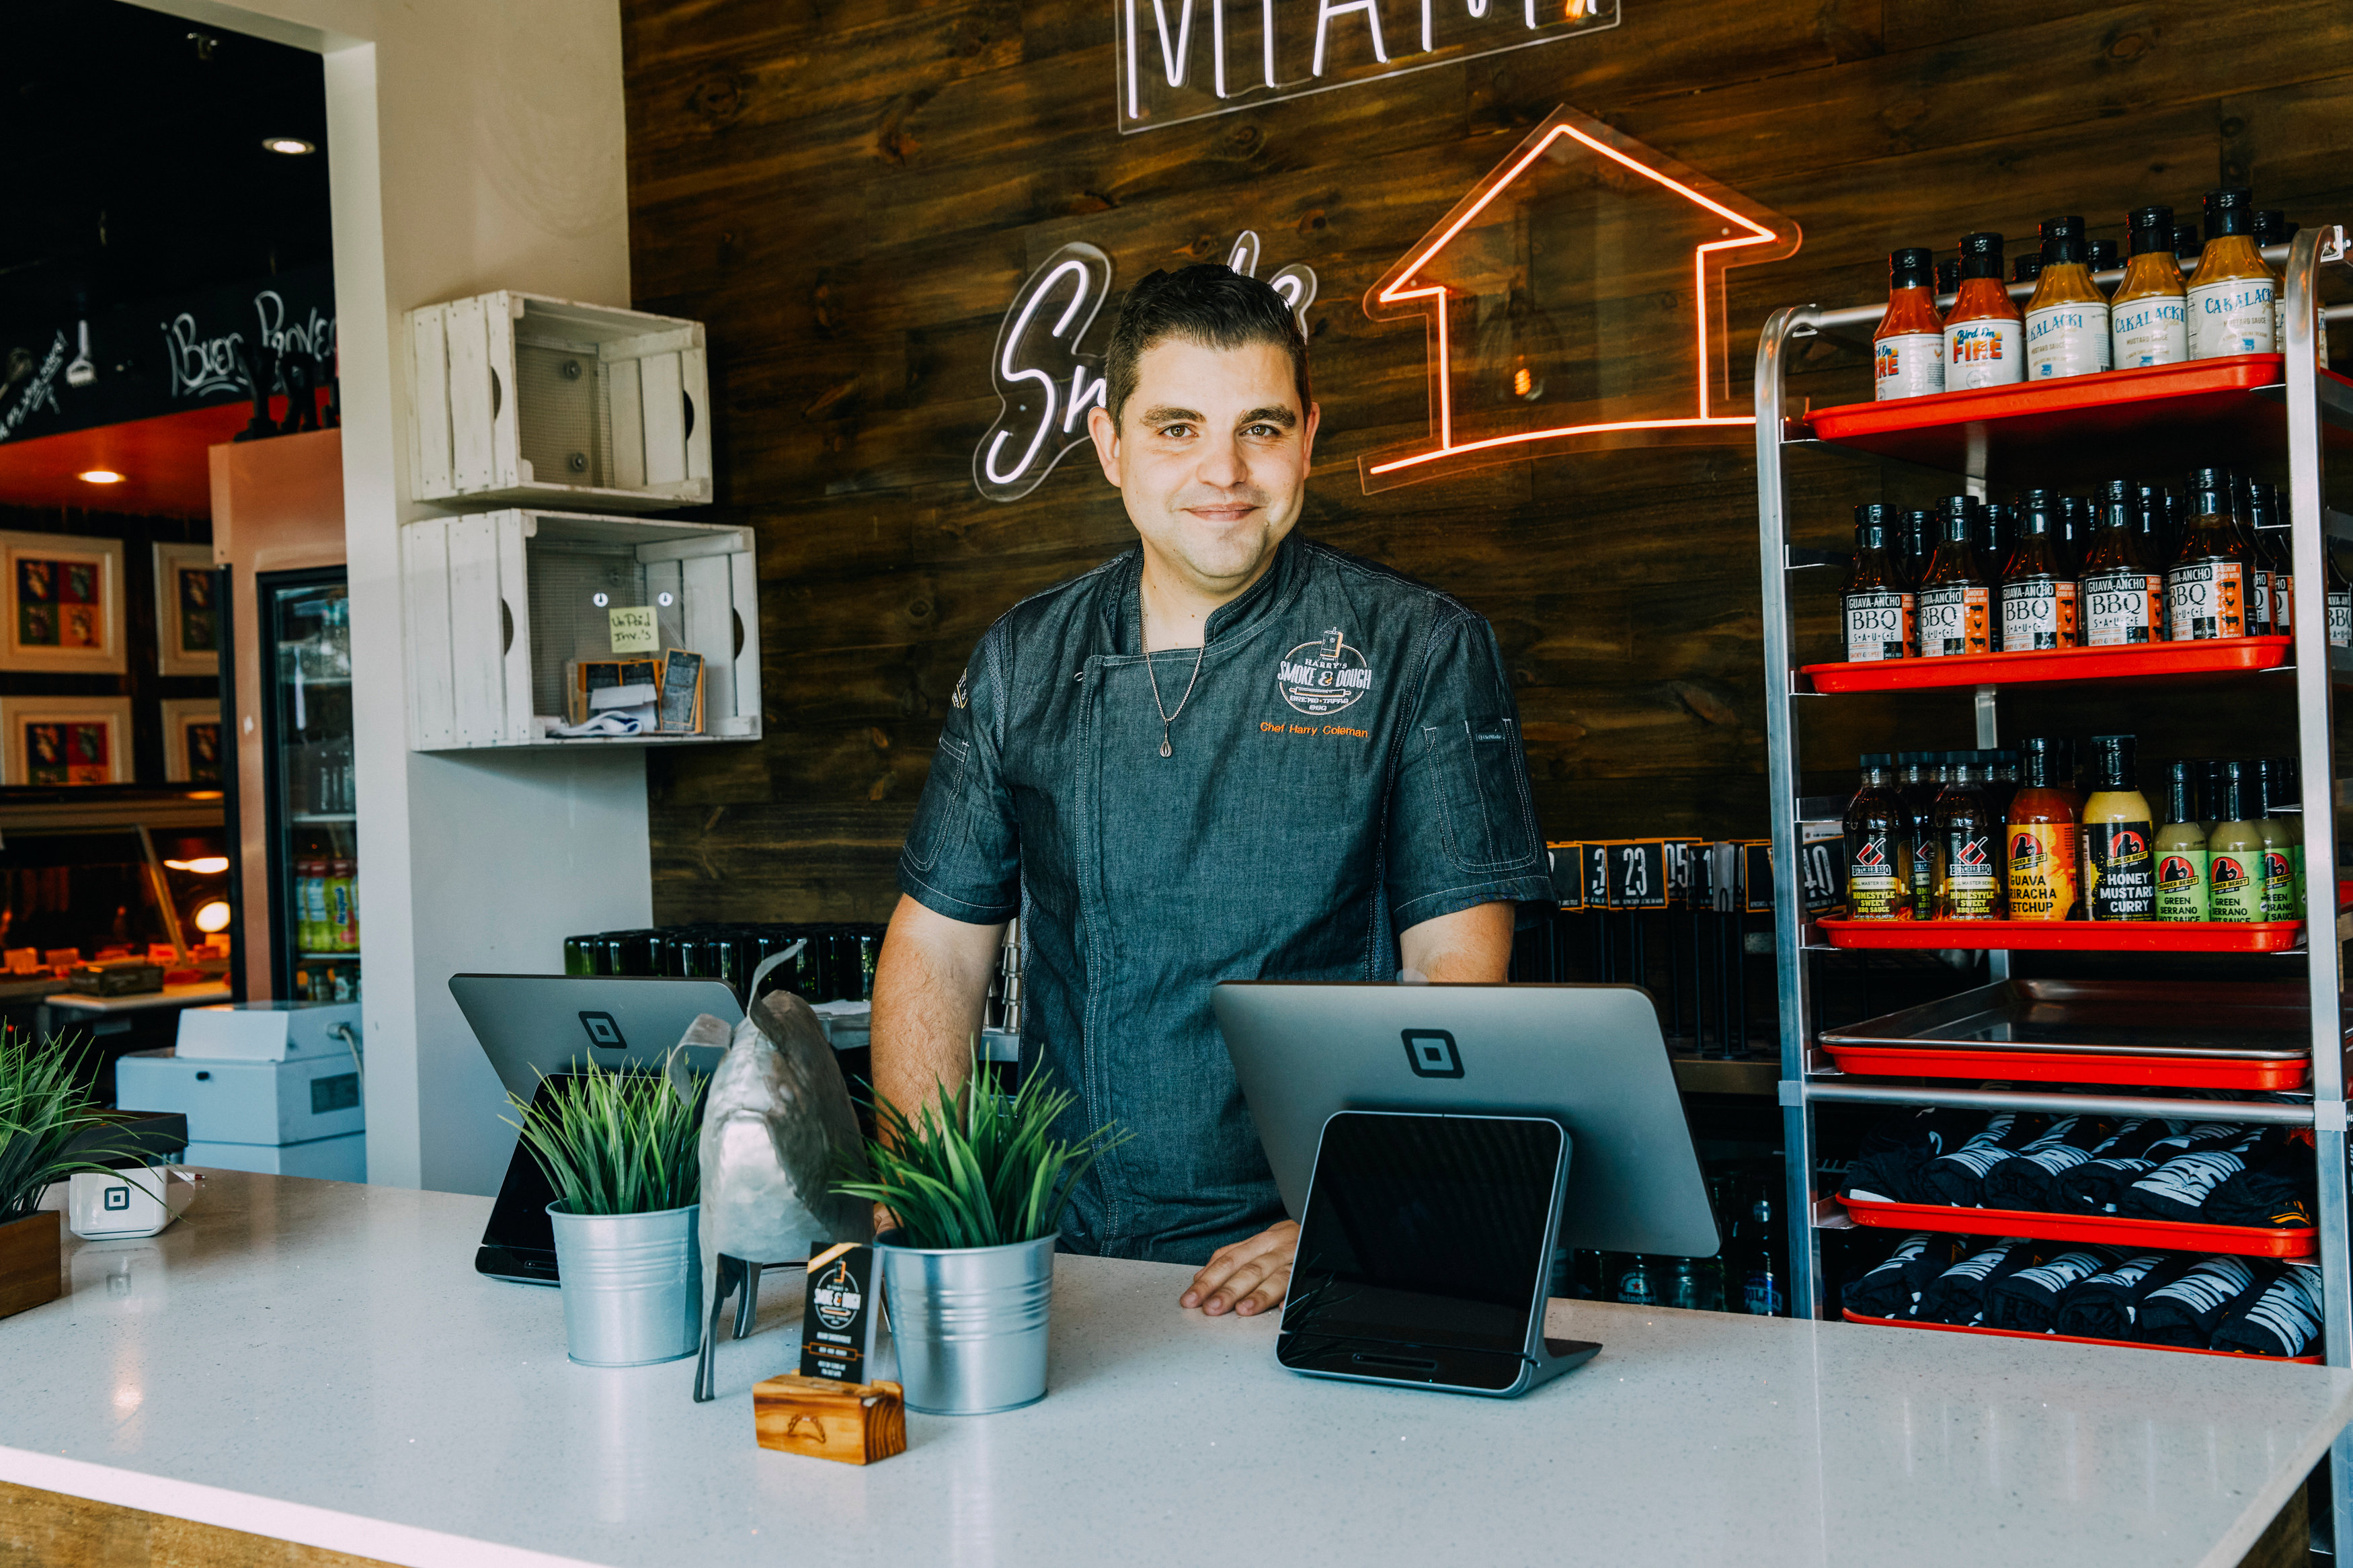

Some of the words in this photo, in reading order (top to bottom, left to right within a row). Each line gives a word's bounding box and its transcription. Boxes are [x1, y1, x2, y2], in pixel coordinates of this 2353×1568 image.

[2115, 306, 2184, 333] CAKALACKI
[1953, 331, 2003, 364] FIRE
[2087, 578, 2145, 593] GUAVA-ANCHO
[2003, 585, 2054, 600] GUAVA-ANCHO
[2169, 583, 2206, 607] BBQ
[1849, 596, 1901, 609] GUAVA-ANCHO
[2093, 593, 2141, 615] BBQ
[1922, 606, 1957, 627] BBQ
[2006, 600, 2049, 621] BBQ
[1853, 610, 1897, 630] BBQ
[1305, 658, 1347, 669] HARRY'S
[1278, 661, 1316, 686] SMOKE
[1318, 671, 1333, 686] &
[1335, 669, 1372, 690] DOUGH
[1260, 722, 1285, 733] Chef
[1289, 724, 1318, 736] Harry
[1323, 725, 1368, 738] Coleman
[1623, 847, 1647, 896] 23
[1853, 866, 1876, 875] BUTCHER
[1877, 865, 1890, 874] BBQ
[1951, 865, 1979, 874] BUTCHER
[1979, 864, 1991, 874] BBQ
[2011, 875, 2046, 886] GUAVA
[2107, 872, 2149, 885] HONEY
[2179, 878, 2196, 886] BEAST
[1853, 891, 1895, 899] HOMESTYLE
[1950, 891, 1994, 899] HOMESTYLE
[2100, 886, 2153, 899] MUSTARD
[2110, 900, 2149, 913] CURRY
[2160, 907, 2197, 915] SERRANO
[2272, 913, 2295, 921] SAUCE
